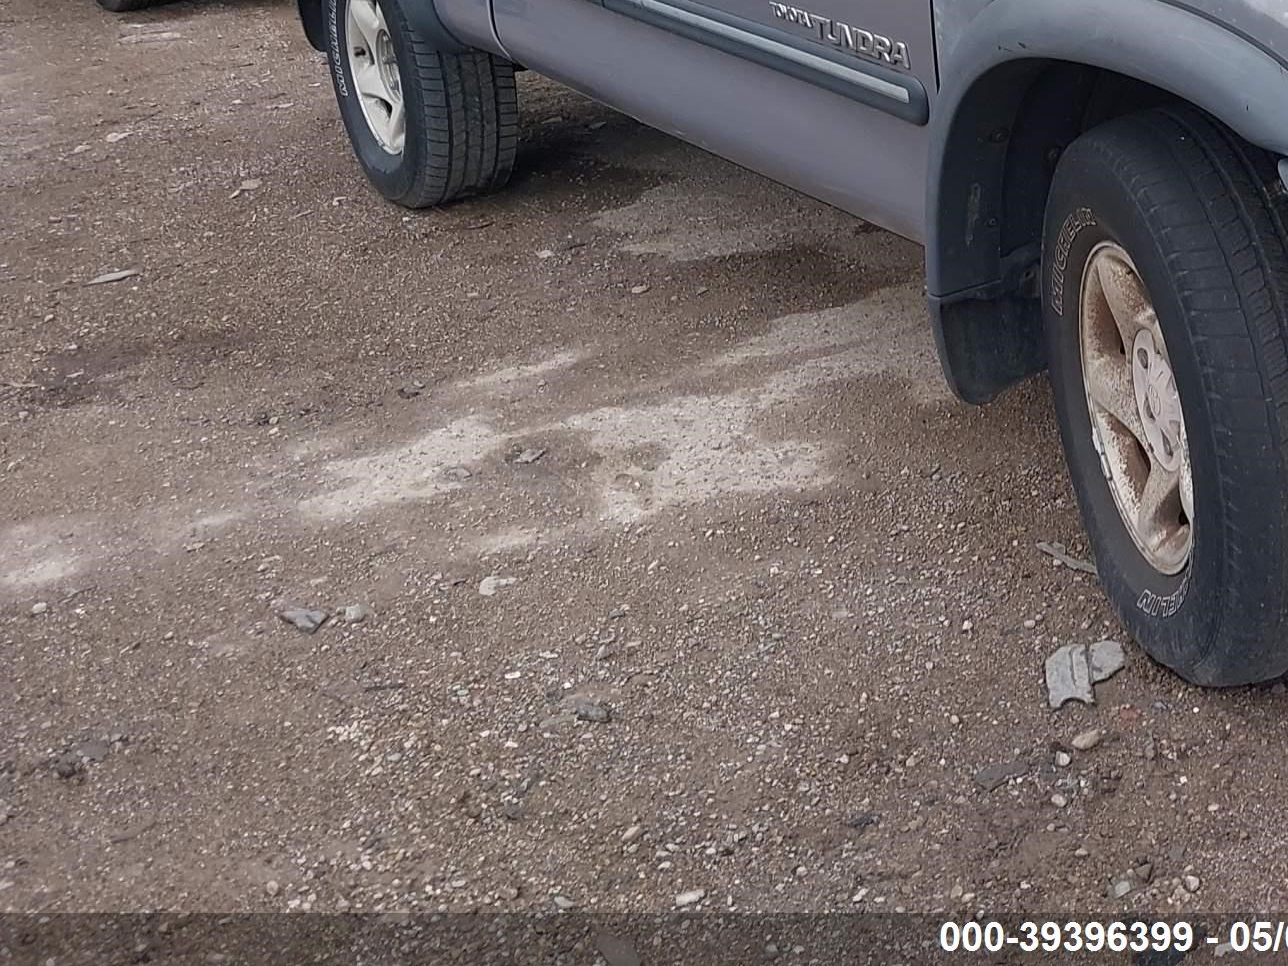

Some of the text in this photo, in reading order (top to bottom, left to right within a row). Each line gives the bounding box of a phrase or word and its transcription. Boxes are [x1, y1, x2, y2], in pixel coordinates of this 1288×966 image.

[768, 0, 911, 70] TOYOTA TUNDRA
[1051, 207, 1097, 316] MICHELIN
